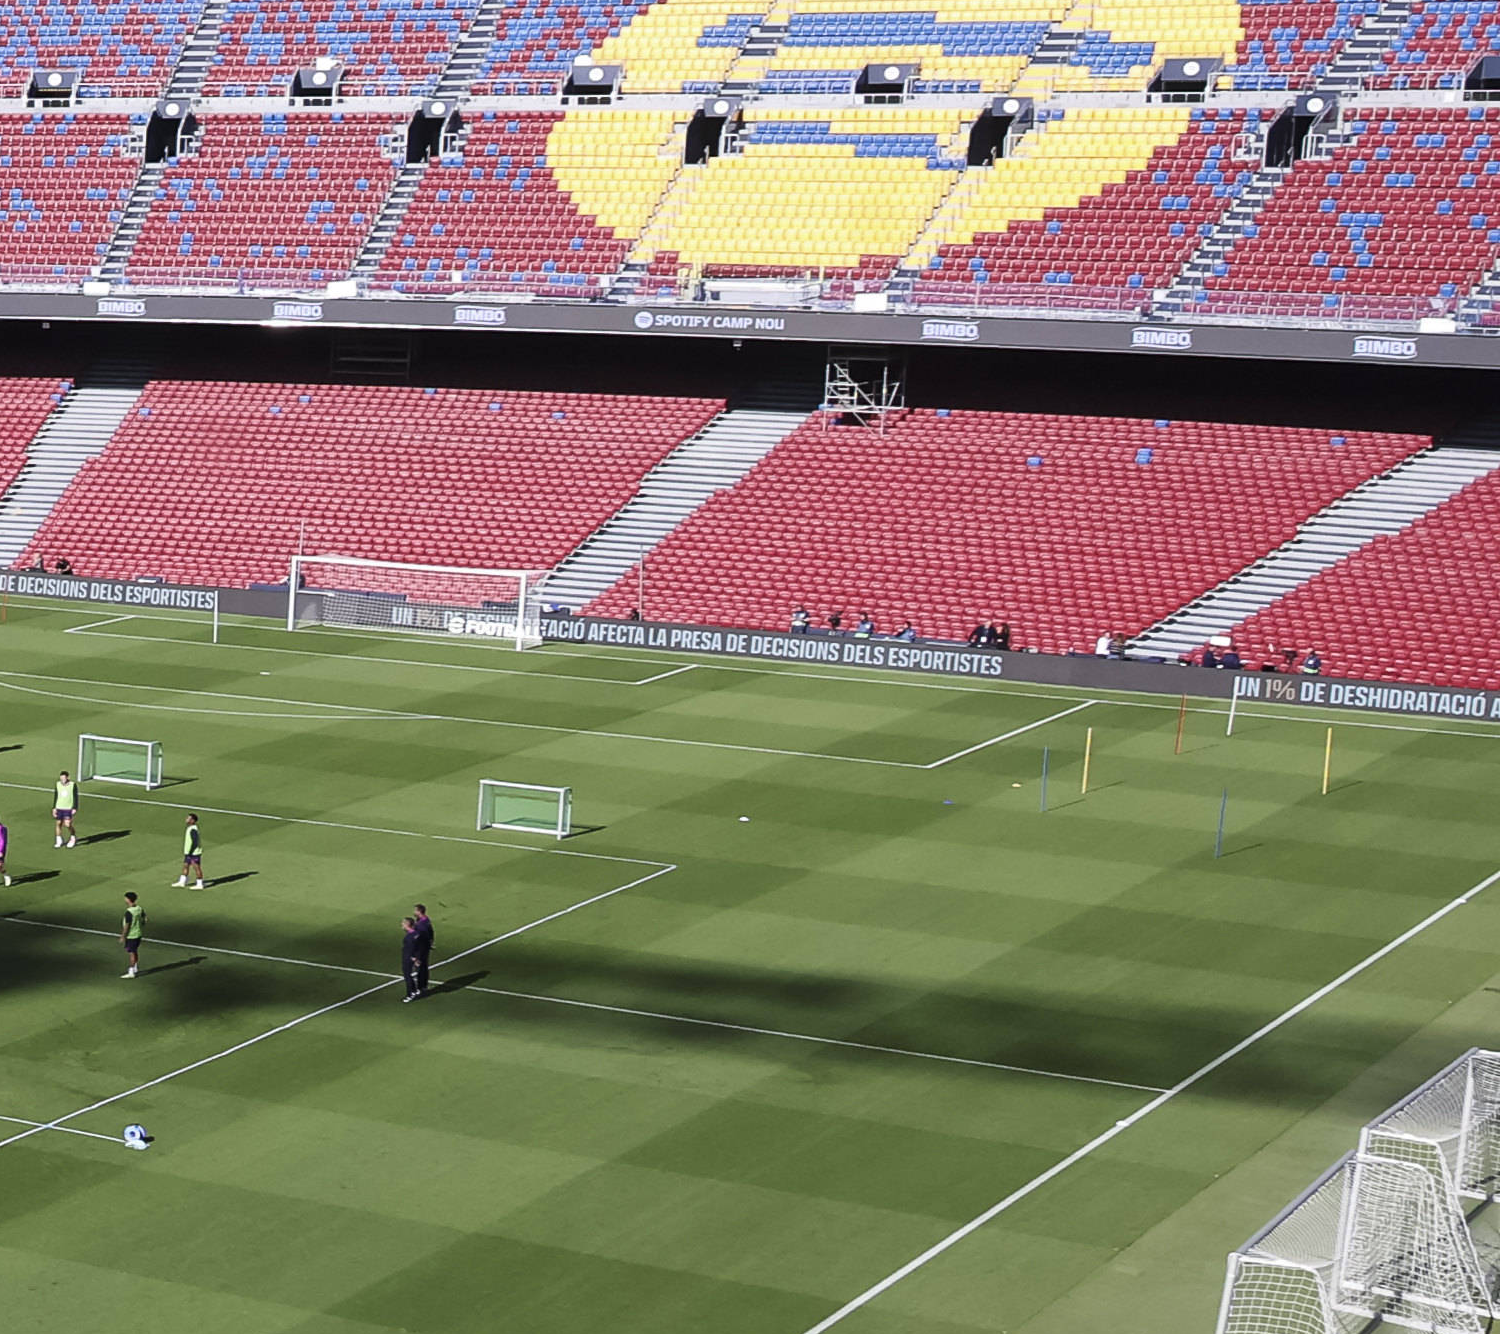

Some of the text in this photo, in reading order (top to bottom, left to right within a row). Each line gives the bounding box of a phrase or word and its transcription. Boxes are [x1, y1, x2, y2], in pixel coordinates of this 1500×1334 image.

[98, 301, 144, 314] BIMBO
[273, 305, 322, 317] BIMBO
[455, 309, 505, 323] BIMBO
[655, 313, 785, 331] SPOTIFY CAMP NOU
[922, 323, 979, 338] BIMBO
[1132, 331, 1191, 346] BIMBO
[1354, 341, 1416, 356] BIMBO
[18, 575, 86, 598] DECISIONS
[89, 582, 122, 601] DELS
[126, 586, 215, 610] ESPORTISTES
[588, 622, 645, 644] AFECTA
[648, 628, 666, 647] LA
[670, 630, 722, 651] PRESA
[725, 633, 747, 653] DE
[750, 635, 840, 662] DECISIONS
[843, 643, 884, 665] DELS
[887, 647, 1003, 676] ESPORTISTES
[1236, 676, 1261, 697] UN
[1264, 678, 1296, 700] 1%
[1300, 681, 1325, 704] DE
[1329, 684, 1486, 717] DESHIDRATACIÓ
